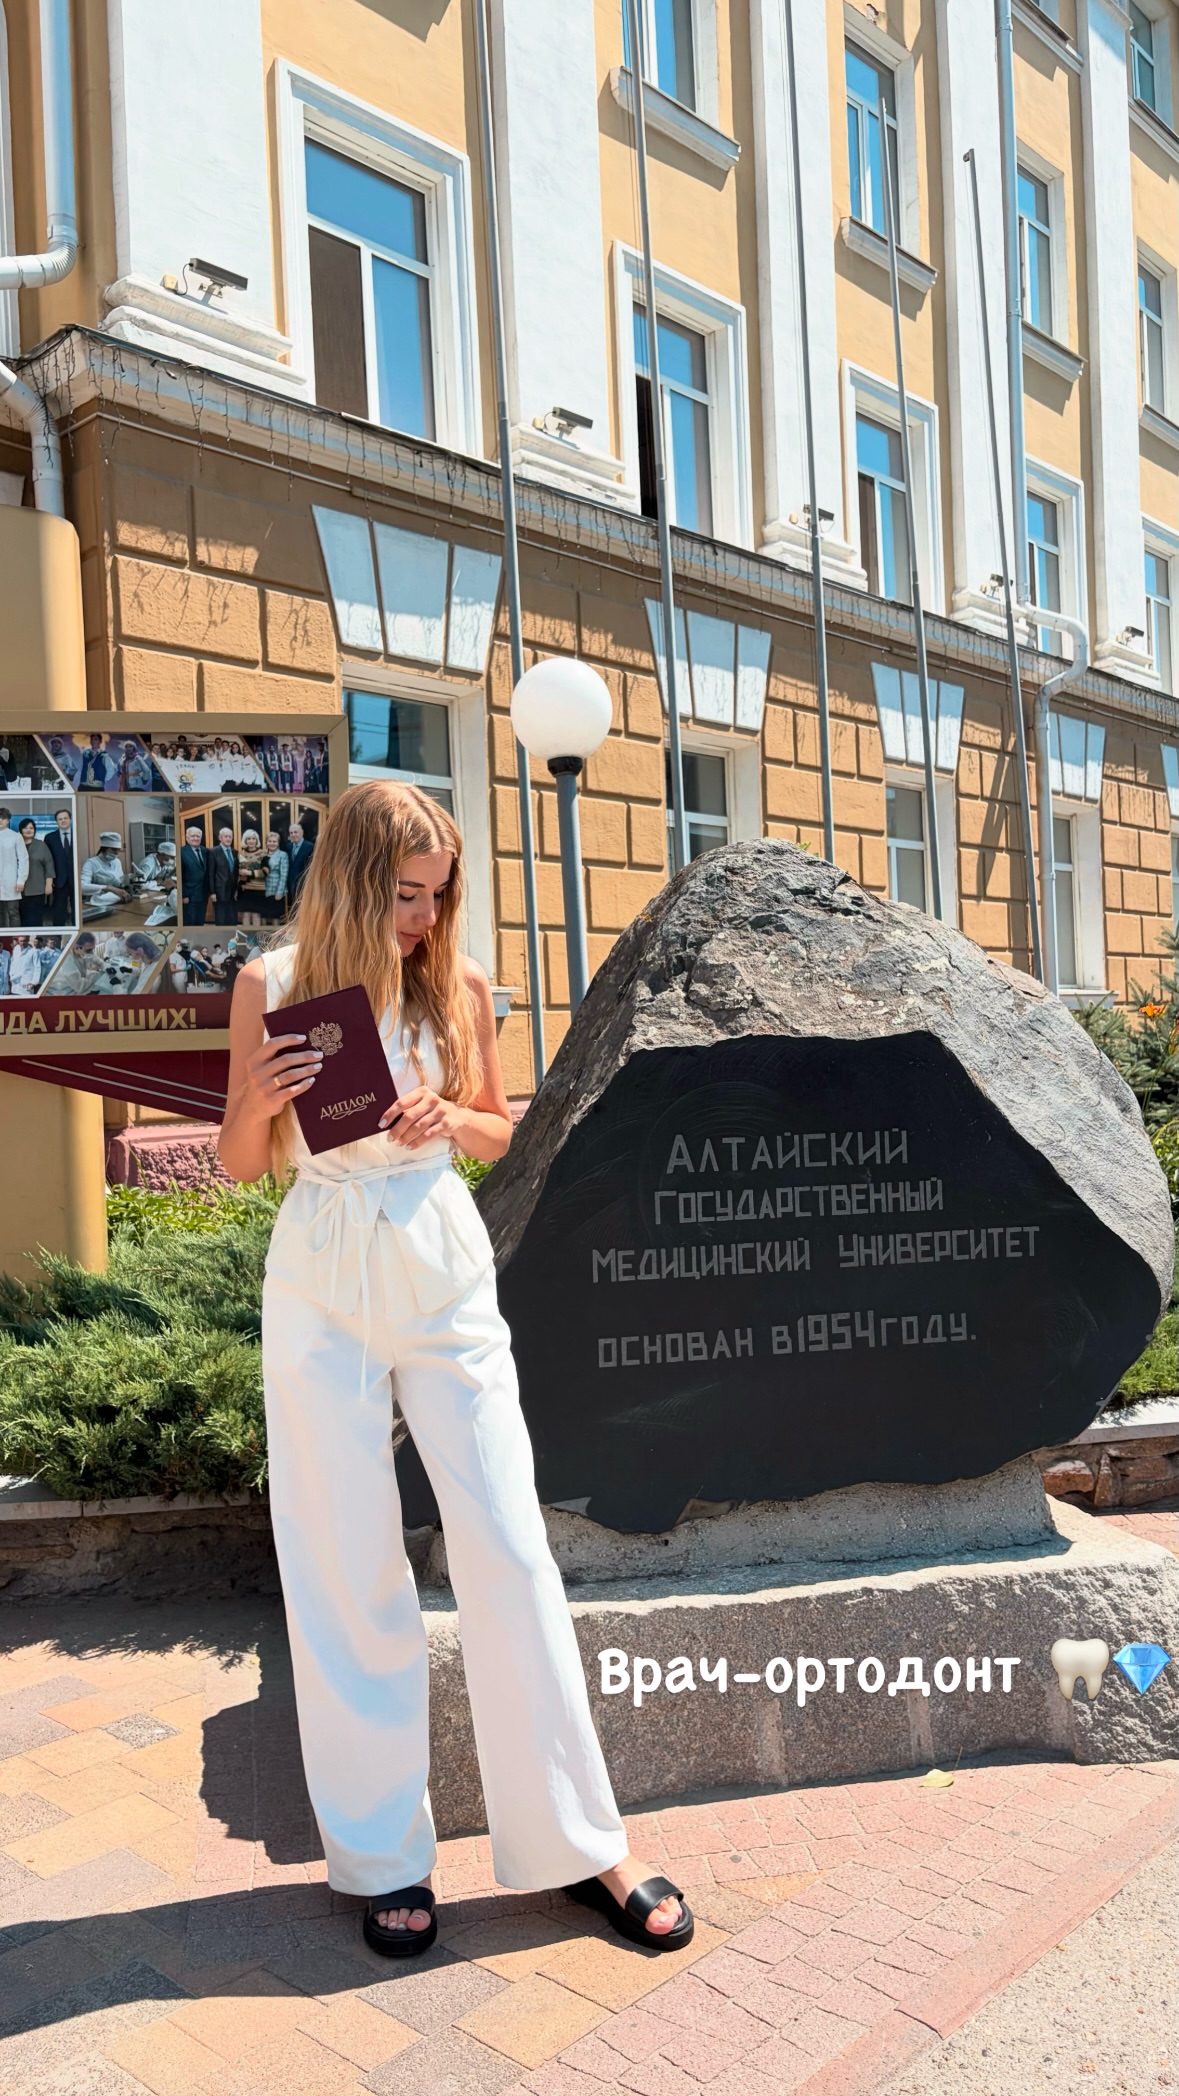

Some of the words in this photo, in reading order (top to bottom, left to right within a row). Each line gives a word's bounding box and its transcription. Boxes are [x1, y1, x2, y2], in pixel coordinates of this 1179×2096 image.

[0, 1011, 47, 1035] ДА
[55, 1007, 197, 1032] ЛУЧШИХ!
[320, 1092, 377, 1120] ДИПЛОМ
[838, 1226, 1040, 1268] УНИВЕРСИТЕТ
